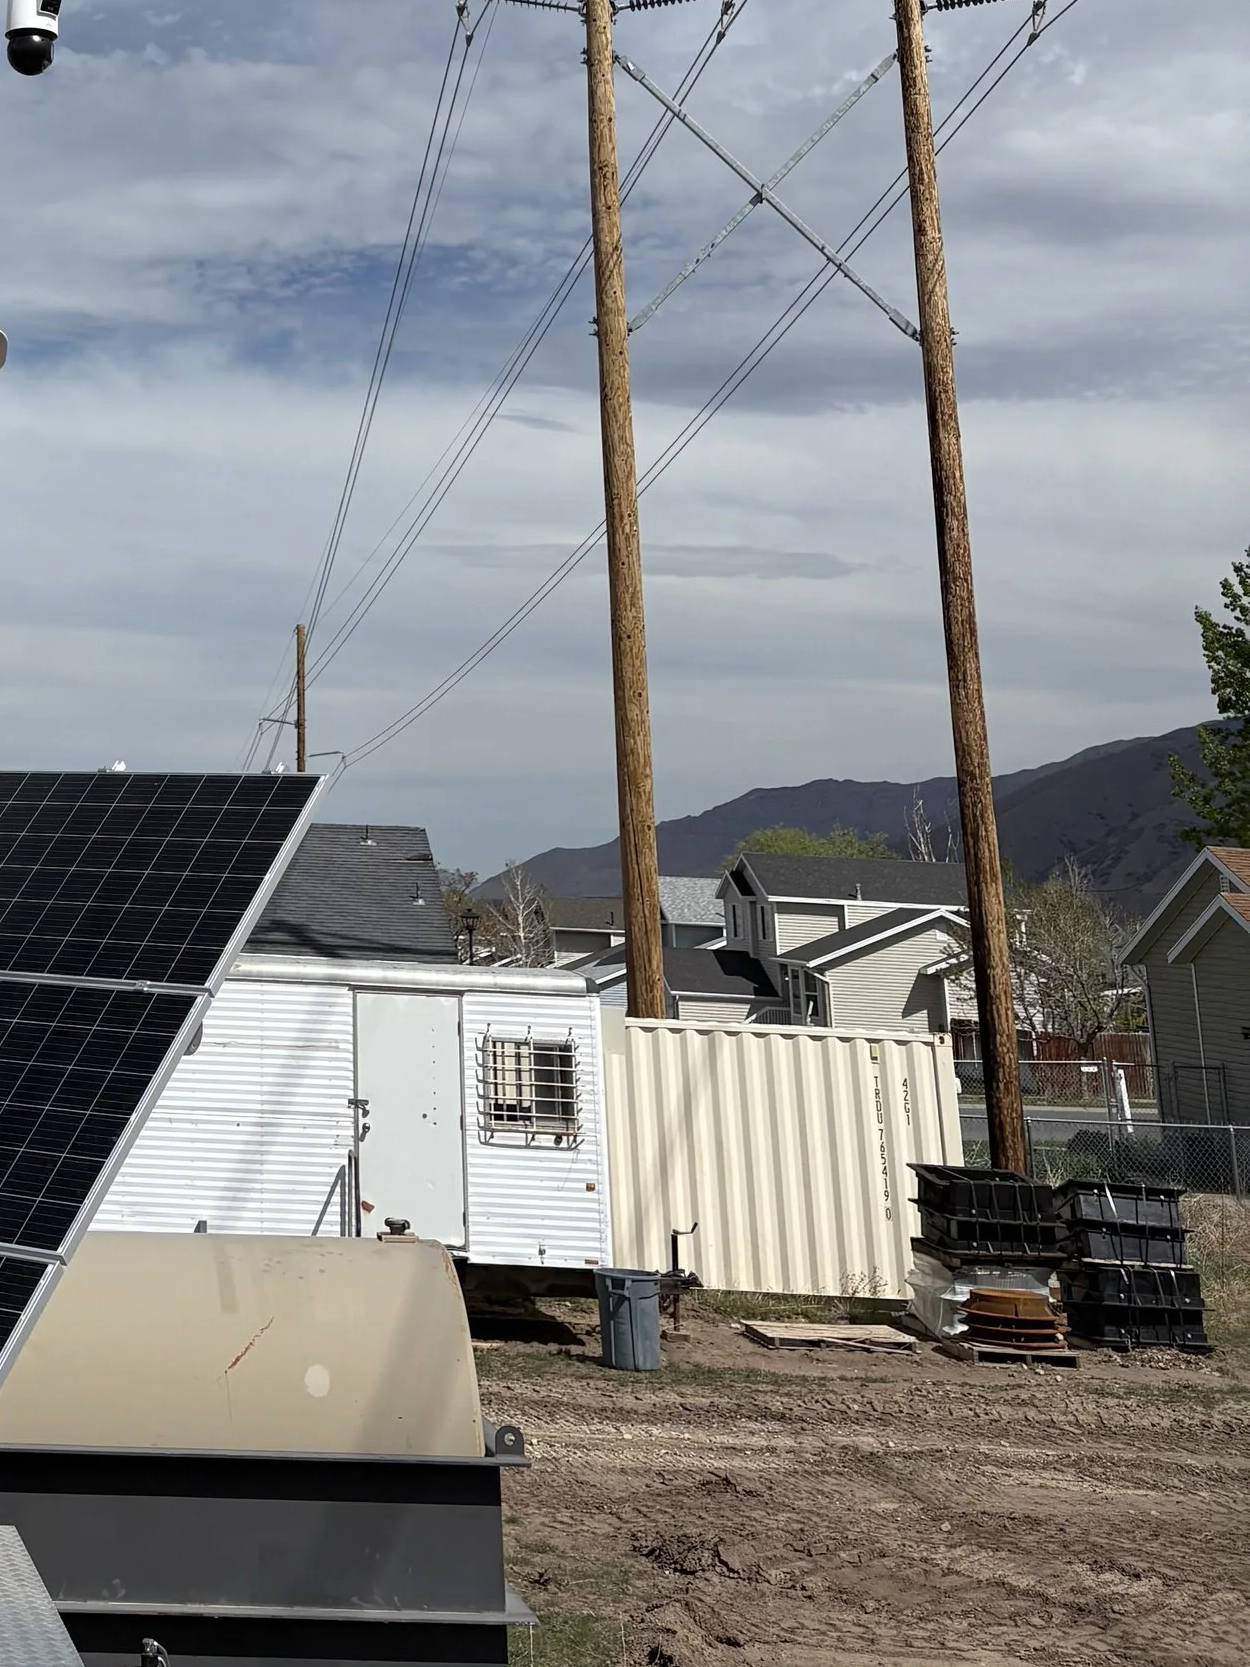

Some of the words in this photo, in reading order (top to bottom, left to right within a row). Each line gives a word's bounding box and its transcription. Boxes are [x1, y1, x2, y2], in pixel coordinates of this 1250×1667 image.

[874, 1076, 883, 1124] TRDU
[902, 1078, 910, 1126] 42G1
[878, 1129, 890, 1202] 765419
